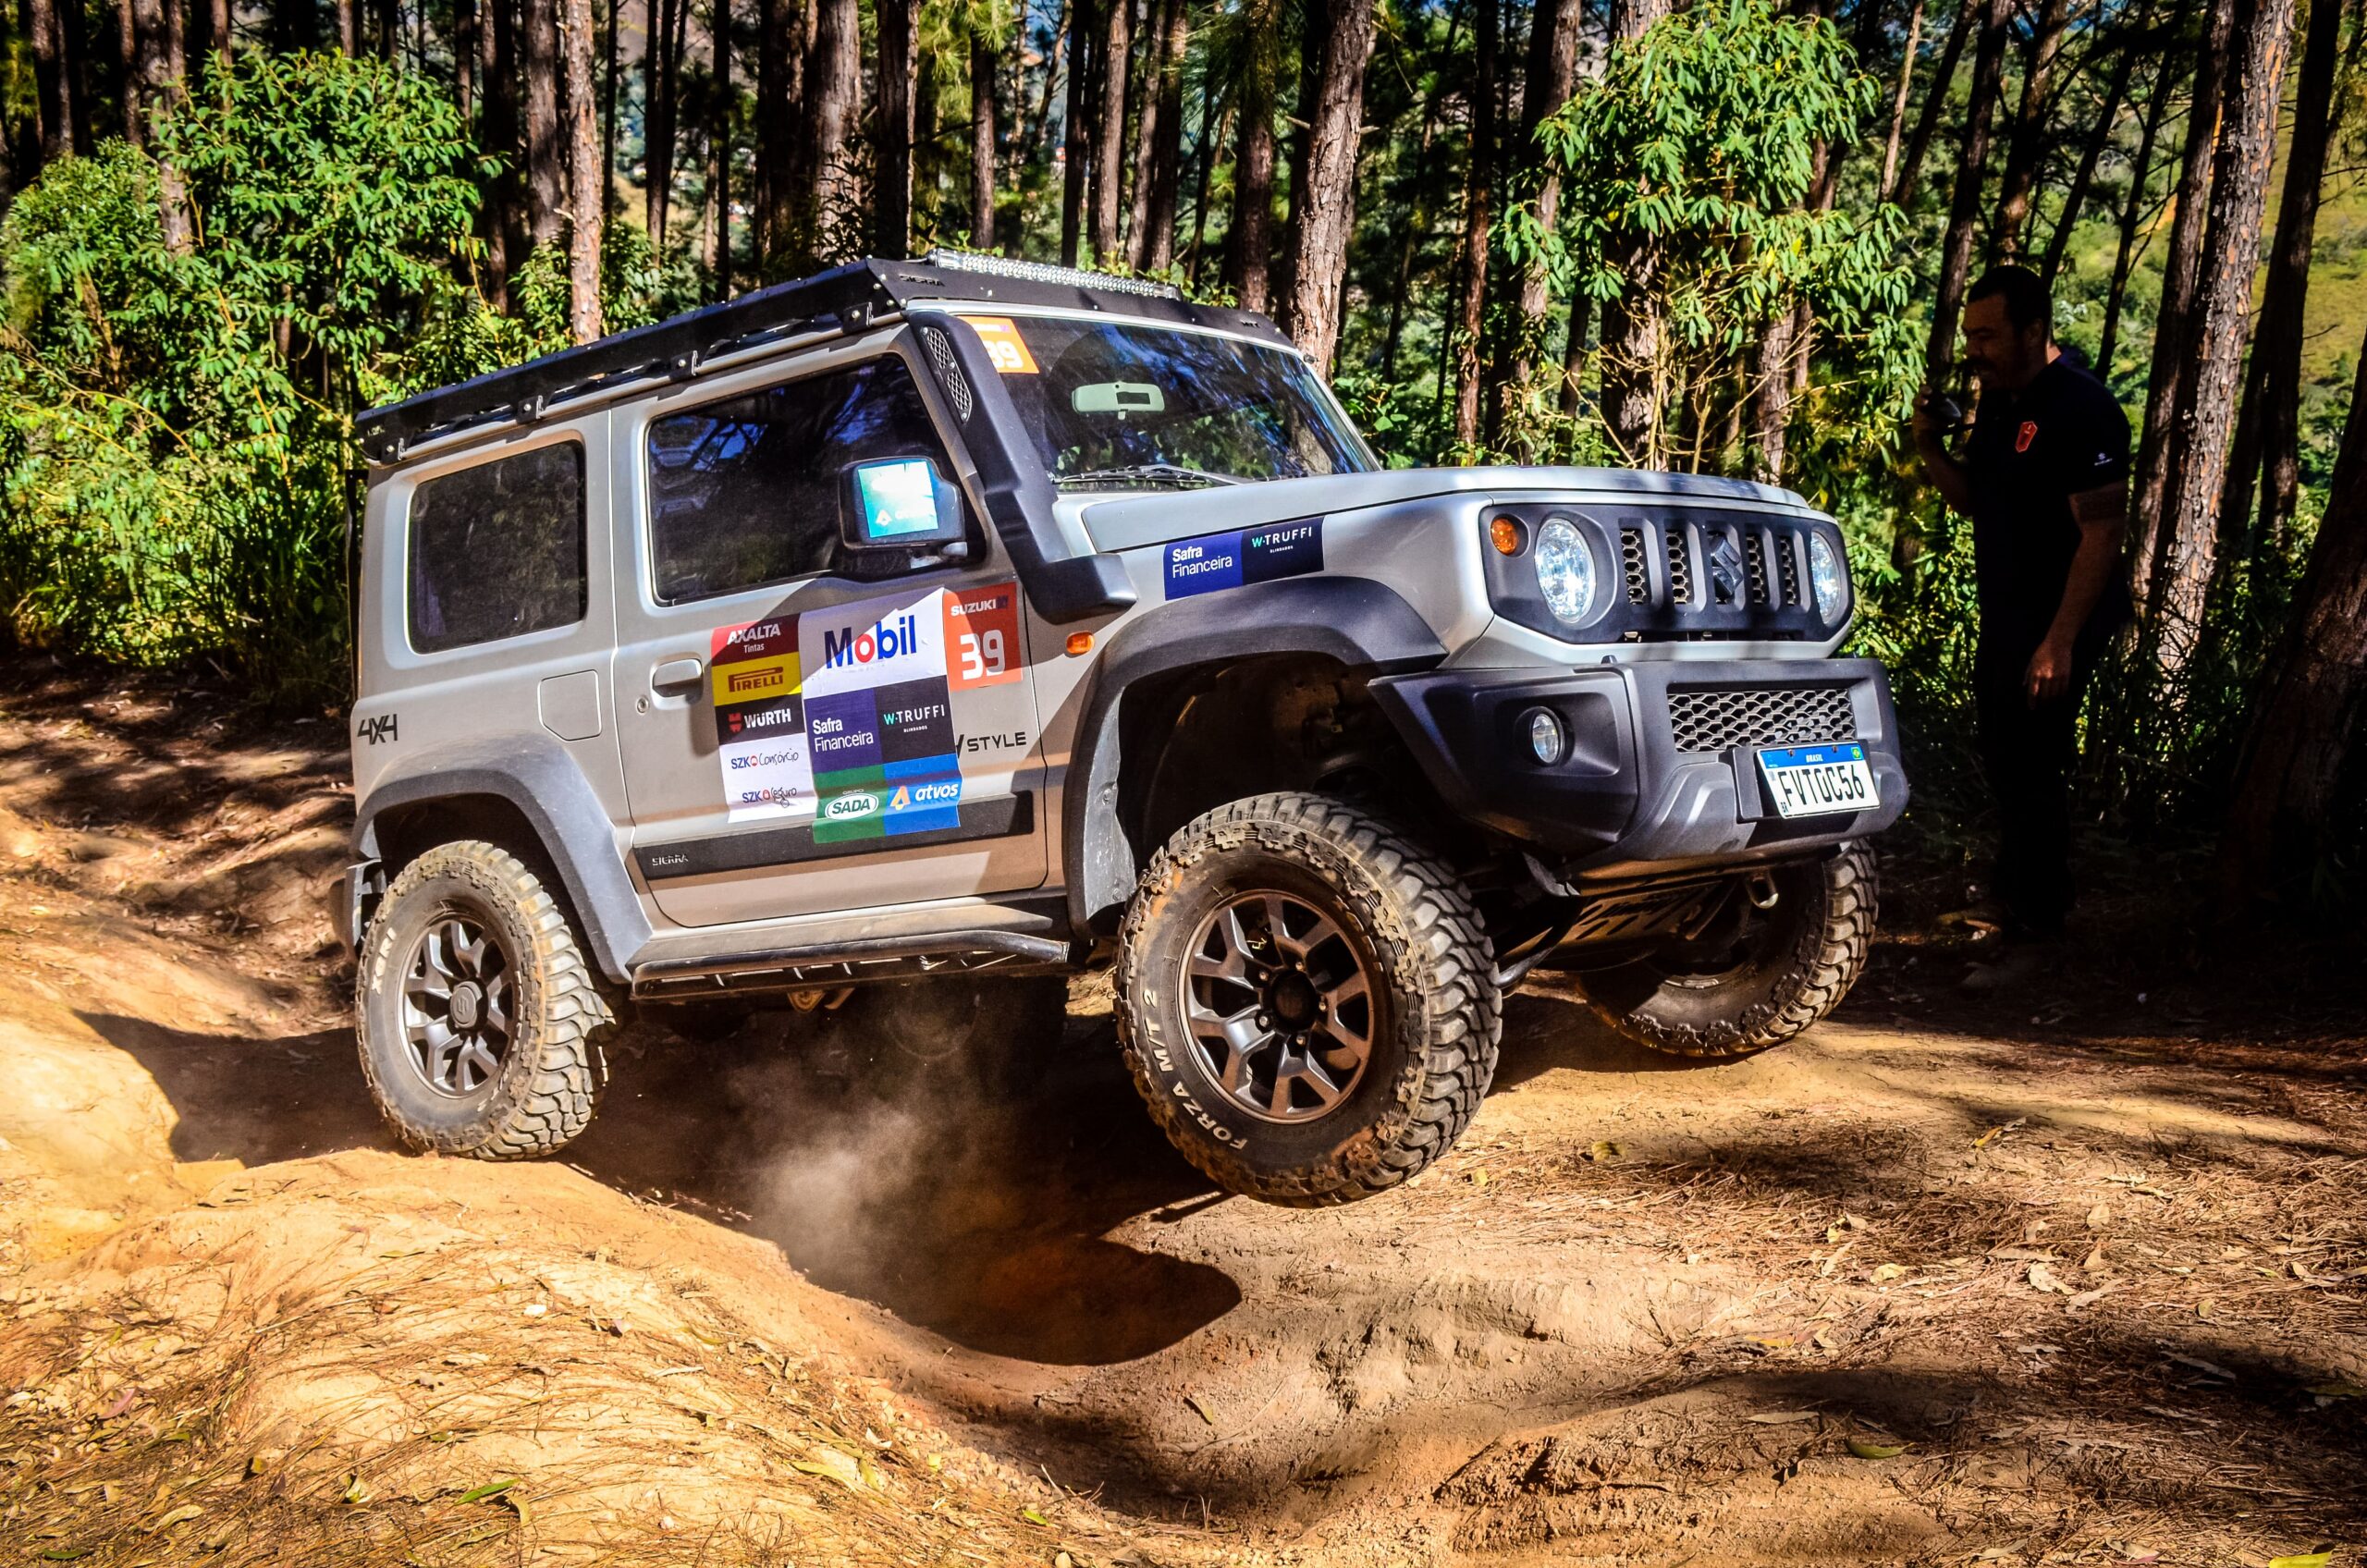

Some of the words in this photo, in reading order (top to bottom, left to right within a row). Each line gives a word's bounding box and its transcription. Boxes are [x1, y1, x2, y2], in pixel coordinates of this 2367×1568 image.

[1171, 546, 1203, 562] Safra
[1171, 556, 1233, 578] Financeira
[950, 599, 997, 616] SUZUKI
[727, 623, 781, 645] AXALTA
[824, 614, 916, 668] Mobil
[743, 643, 765, 654] Tintas
[960, 629, 1006, 680] 39
[728, 667, 784, 692] PIRELLI
[812, 717, 843, 735] Safra
[815, 731, 874, 753] Financeira
[1806, 753, 1823, 763] BRASIL
[914, 784, 959, 802] atvos
[832, 799, 871, 815] SADA
[1143, 989, 1157, 1008] 2
[1144, 1017, 1174, 1072] M/T
[1172, 1081, 1248, 1150] FORZA
